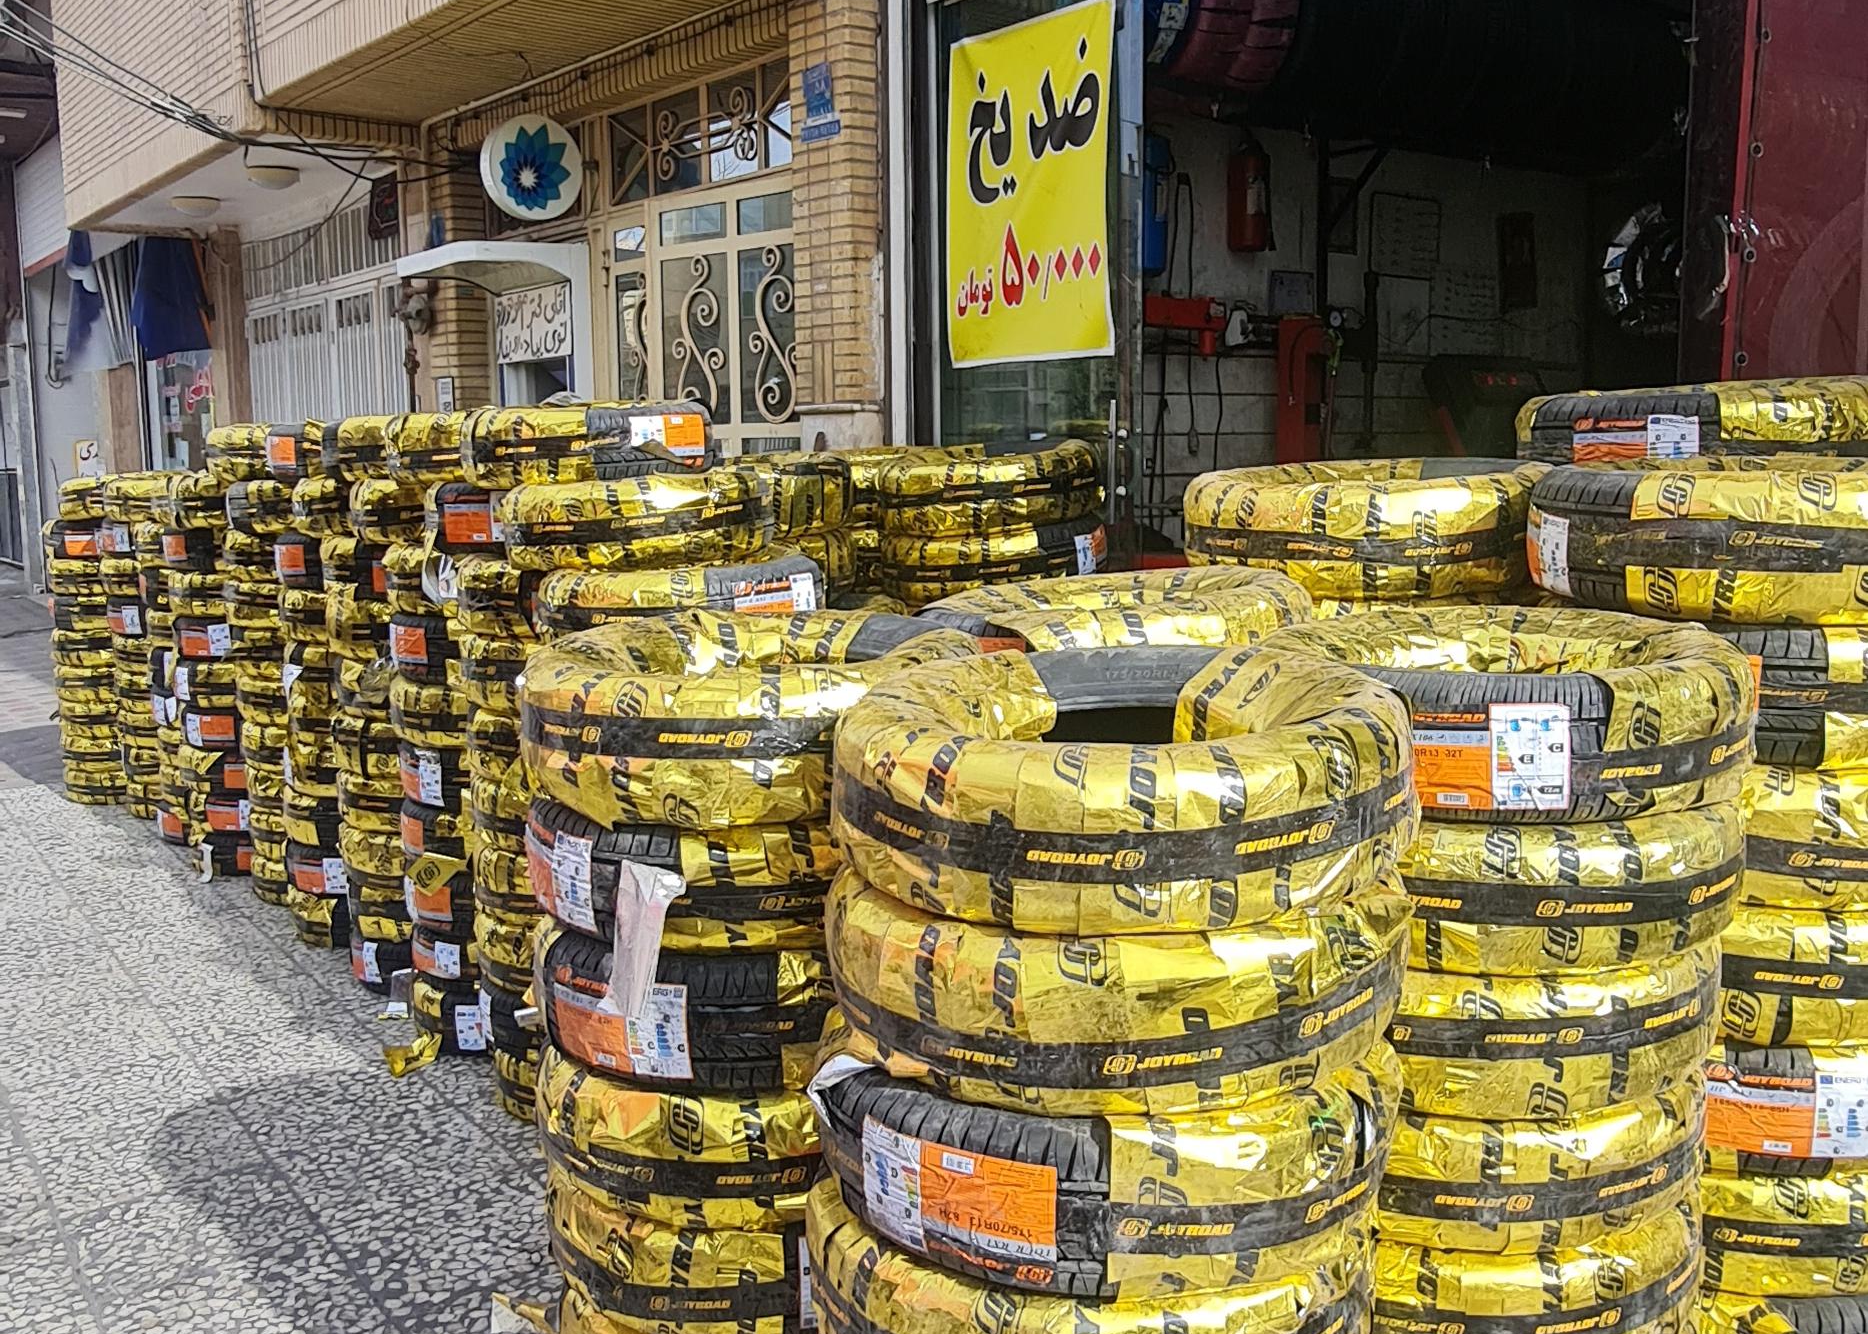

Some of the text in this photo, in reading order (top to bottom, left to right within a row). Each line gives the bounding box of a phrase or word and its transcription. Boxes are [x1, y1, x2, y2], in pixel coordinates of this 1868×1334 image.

[969, 36, 1101, 204] ضد یخ
[957, 268, 993, 318] تومان
[658, 733, 725, 745] JOYROAD
[1234, 830, 1310, 856] JOYROAD
[1026, 850, 1113, 866] JOYROAD
[1565, 902, 1633, 914] JOYROAD
[1324, 987, 1374, 1024] JOYROAD
[1137, 1047, 1223, 1069] JOYROAD
[1741, 1075, 1813, 1087] JOYROAD
[1737, 1233, 1801, 1247] JOYROAD
